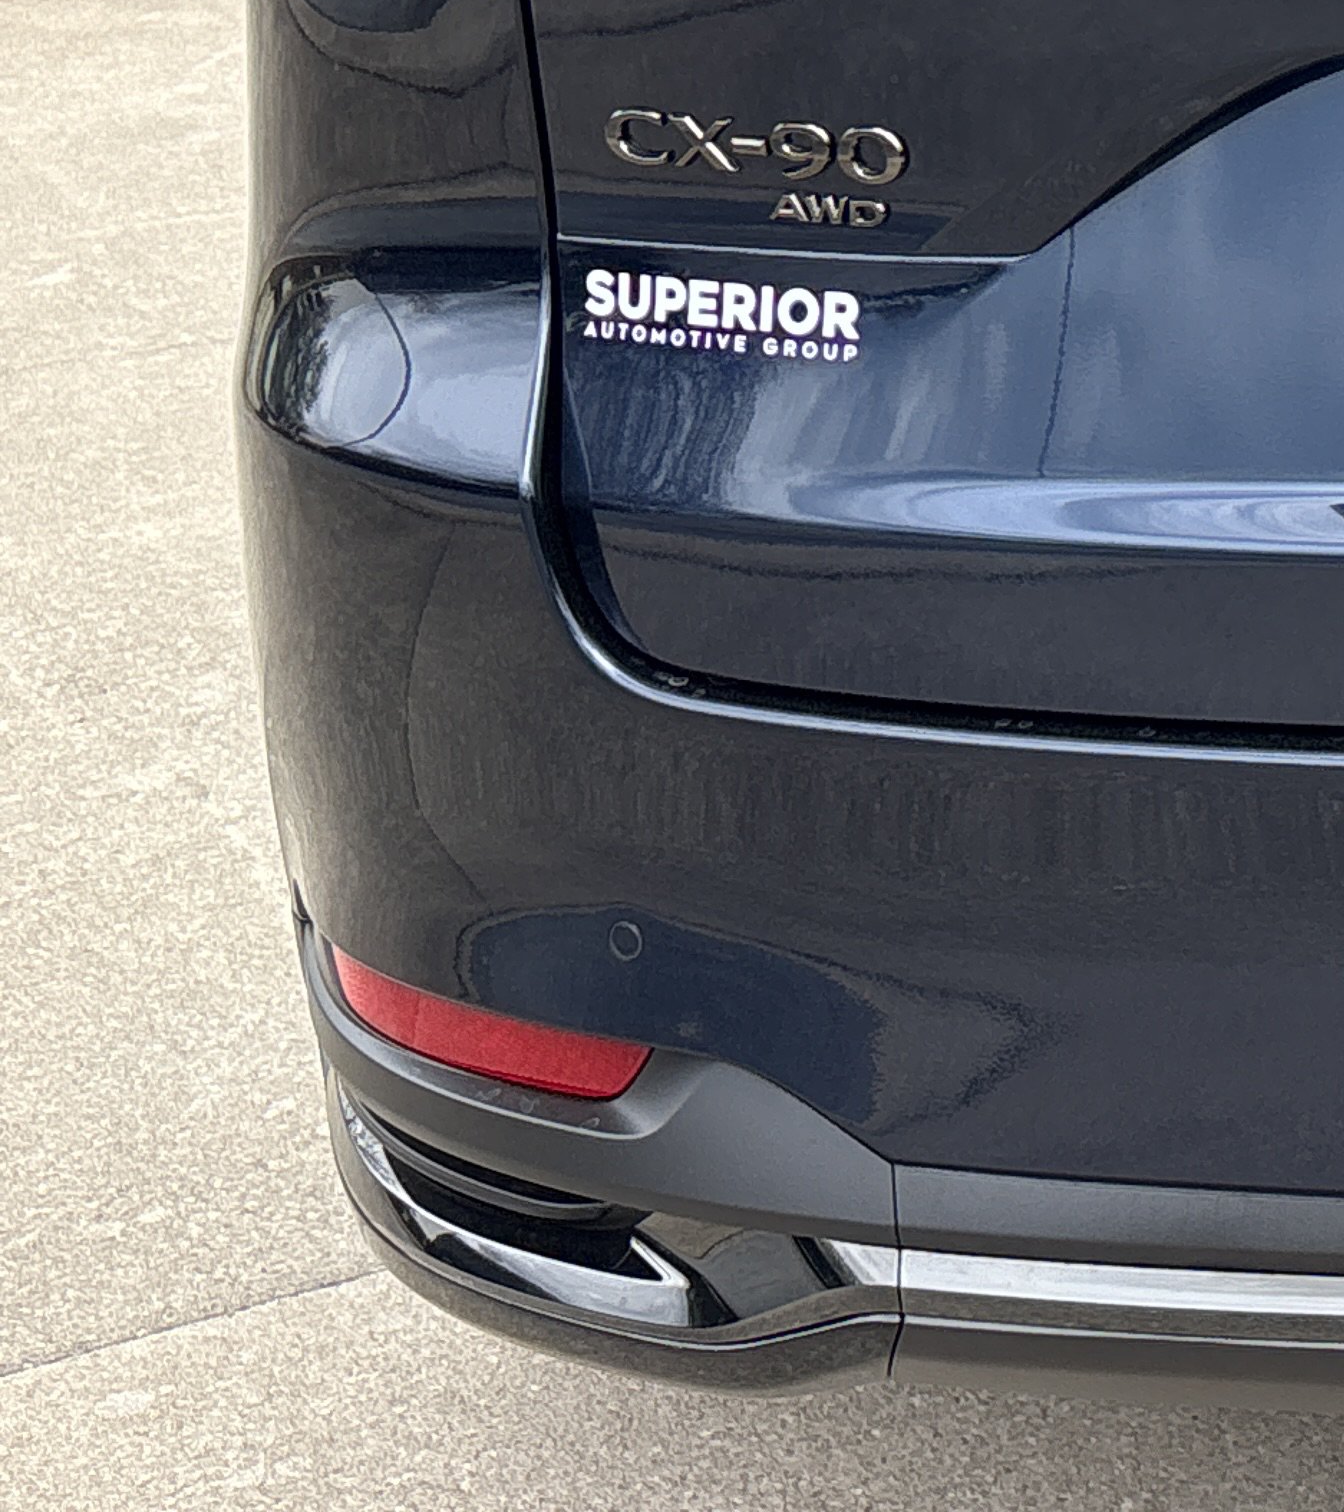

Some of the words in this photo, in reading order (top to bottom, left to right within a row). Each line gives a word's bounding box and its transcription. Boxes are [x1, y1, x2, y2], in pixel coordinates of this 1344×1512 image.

[605, 109, 905, 186] CX-90
[769, 192, 887, 228] AWD
[584, 268, 861, 340] SUPERIOR
[583, 321, 747, 353] AUTOMOTIVE
[762, 337, 859, 362] GROUP
